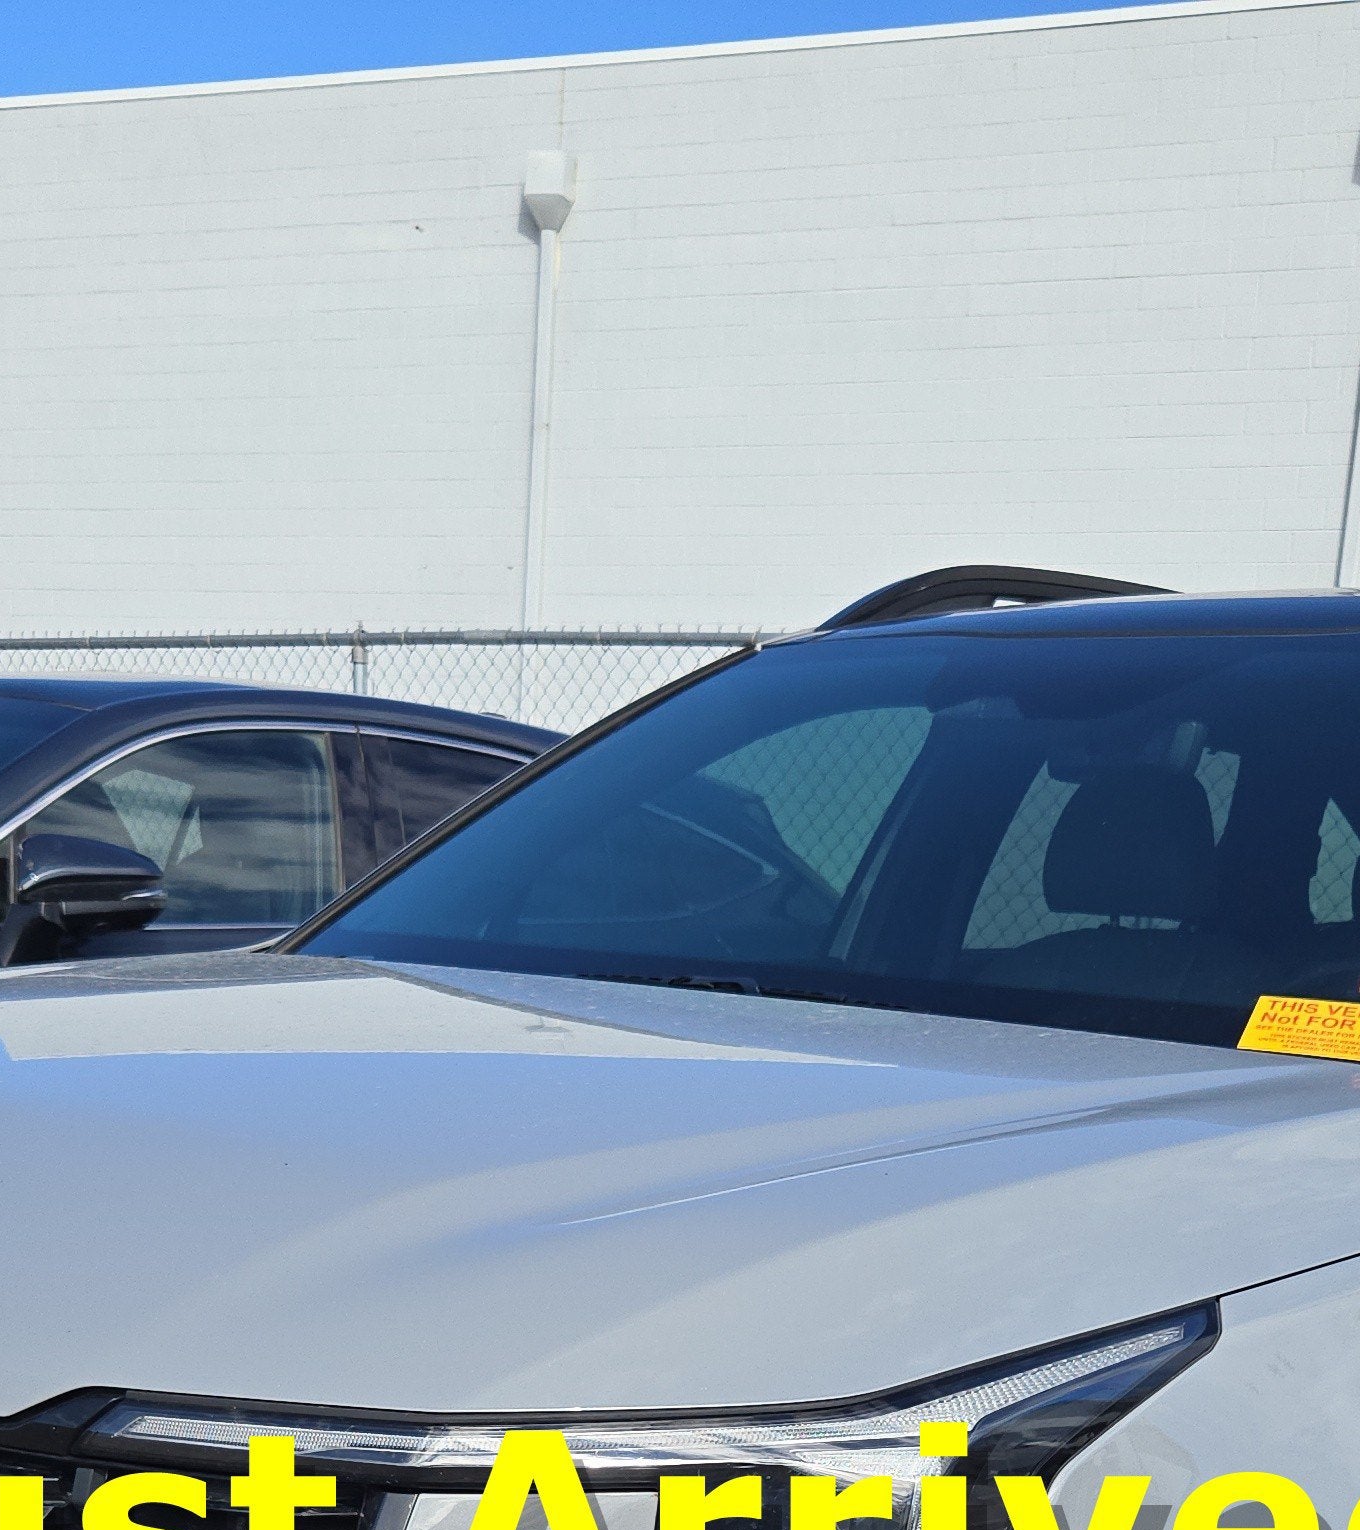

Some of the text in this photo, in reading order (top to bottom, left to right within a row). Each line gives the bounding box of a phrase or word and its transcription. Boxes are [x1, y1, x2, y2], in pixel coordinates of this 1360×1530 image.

[1269, 1000, 1319, 1014] THIS
[1260, 1011, 1300, 1026] Not
[1305, 1015, 1357, 1031] FOR
[1295, 1028, 1334, 1037] DEALER
[1335, 1031, 1355, 1039] FOR
